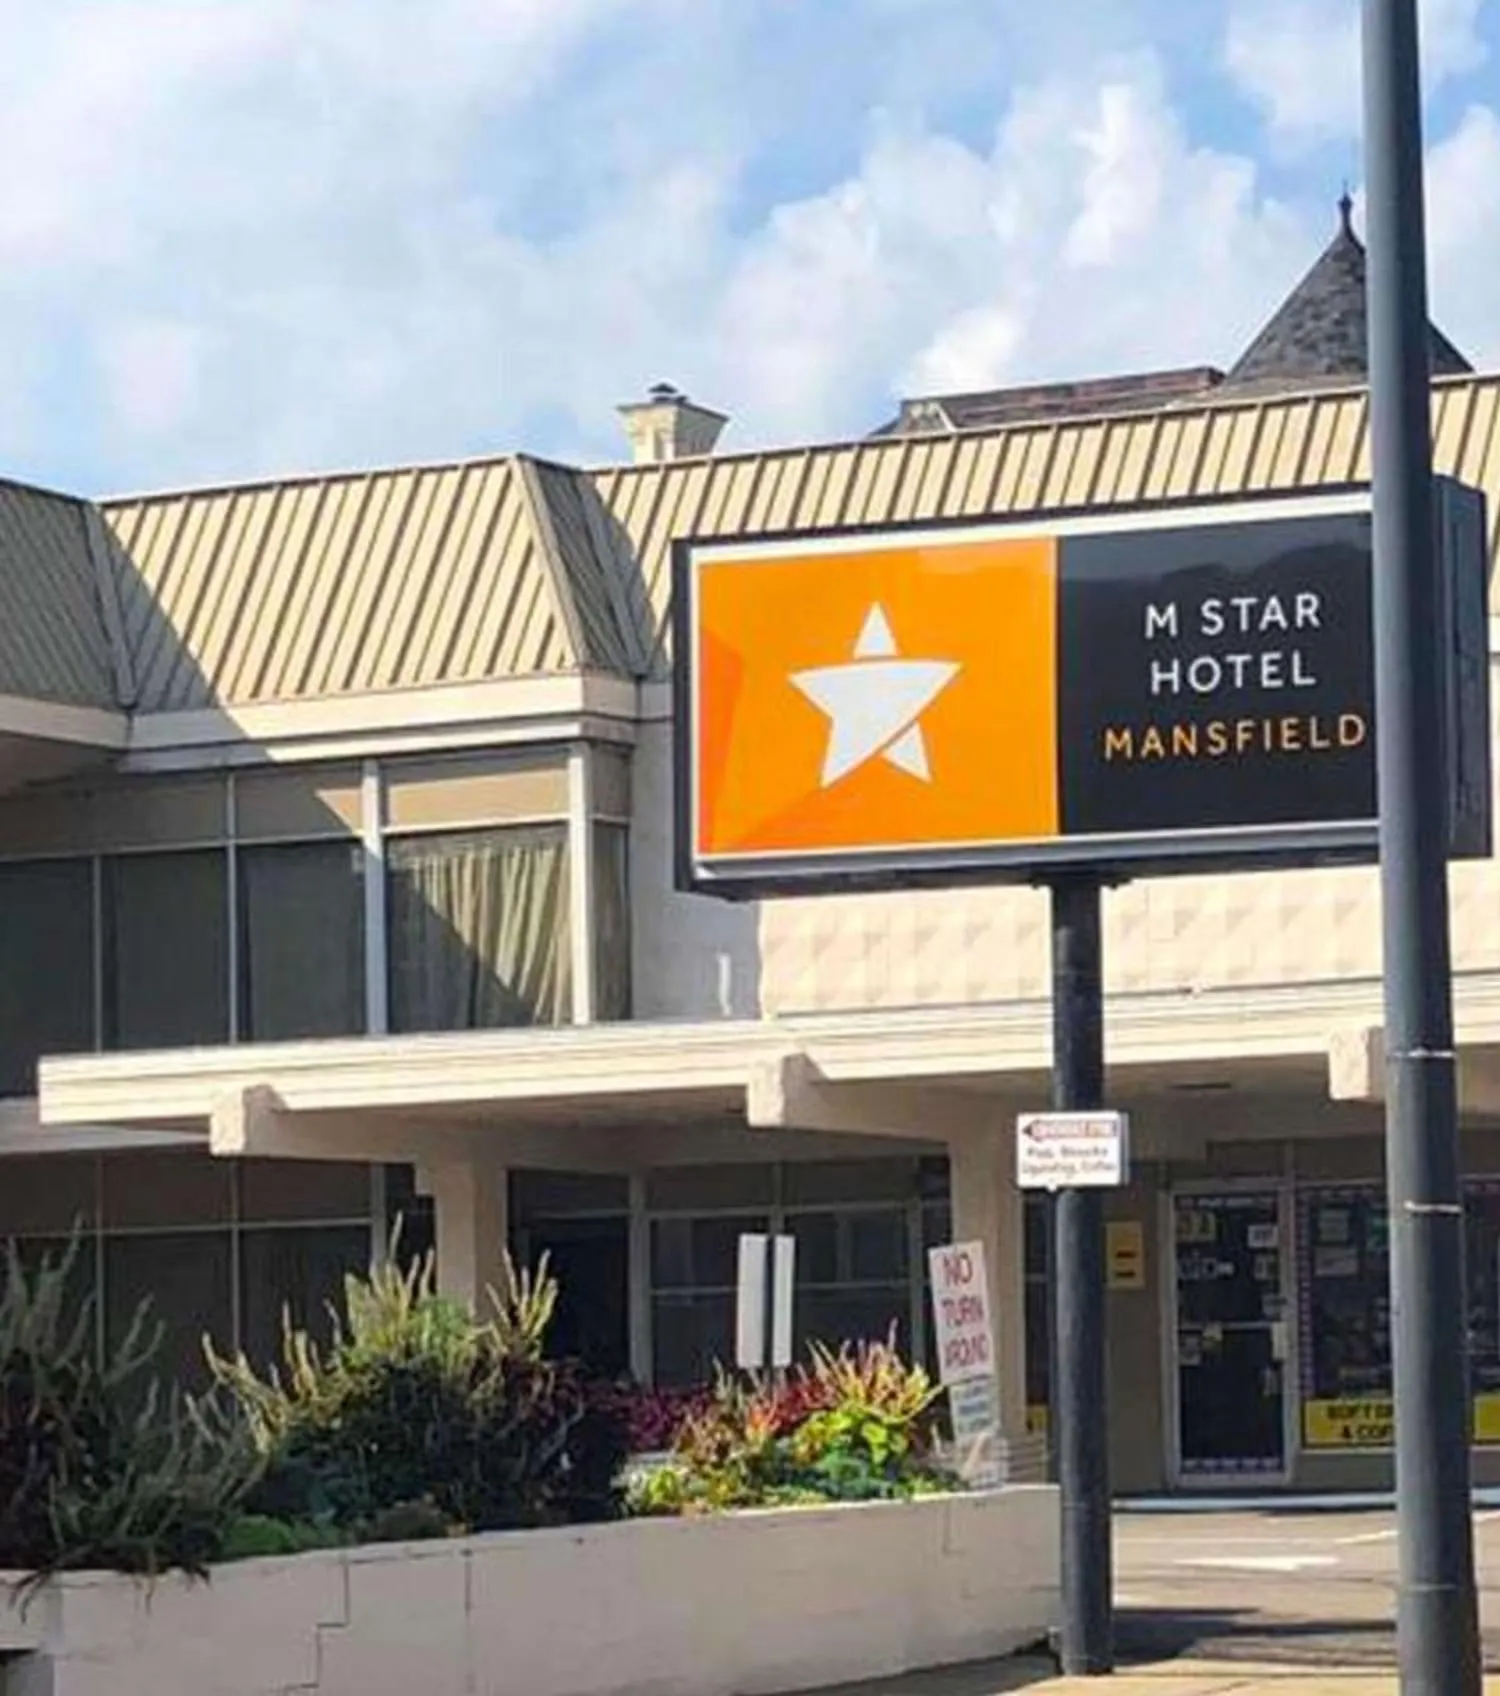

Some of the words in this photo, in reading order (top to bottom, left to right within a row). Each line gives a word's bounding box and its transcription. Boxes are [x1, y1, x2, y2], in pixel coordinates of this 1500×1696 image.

[1145, 602, 1178, 640] M
[1200, 592, 1321, 636] STAR
[1151, 650, 1317, 695] HOTEL
[1104, 713, 1366, 762] MANSFIELD
[942, 1252, 973, 1287] NO
[942, 1294, 985, 1328] TURN
